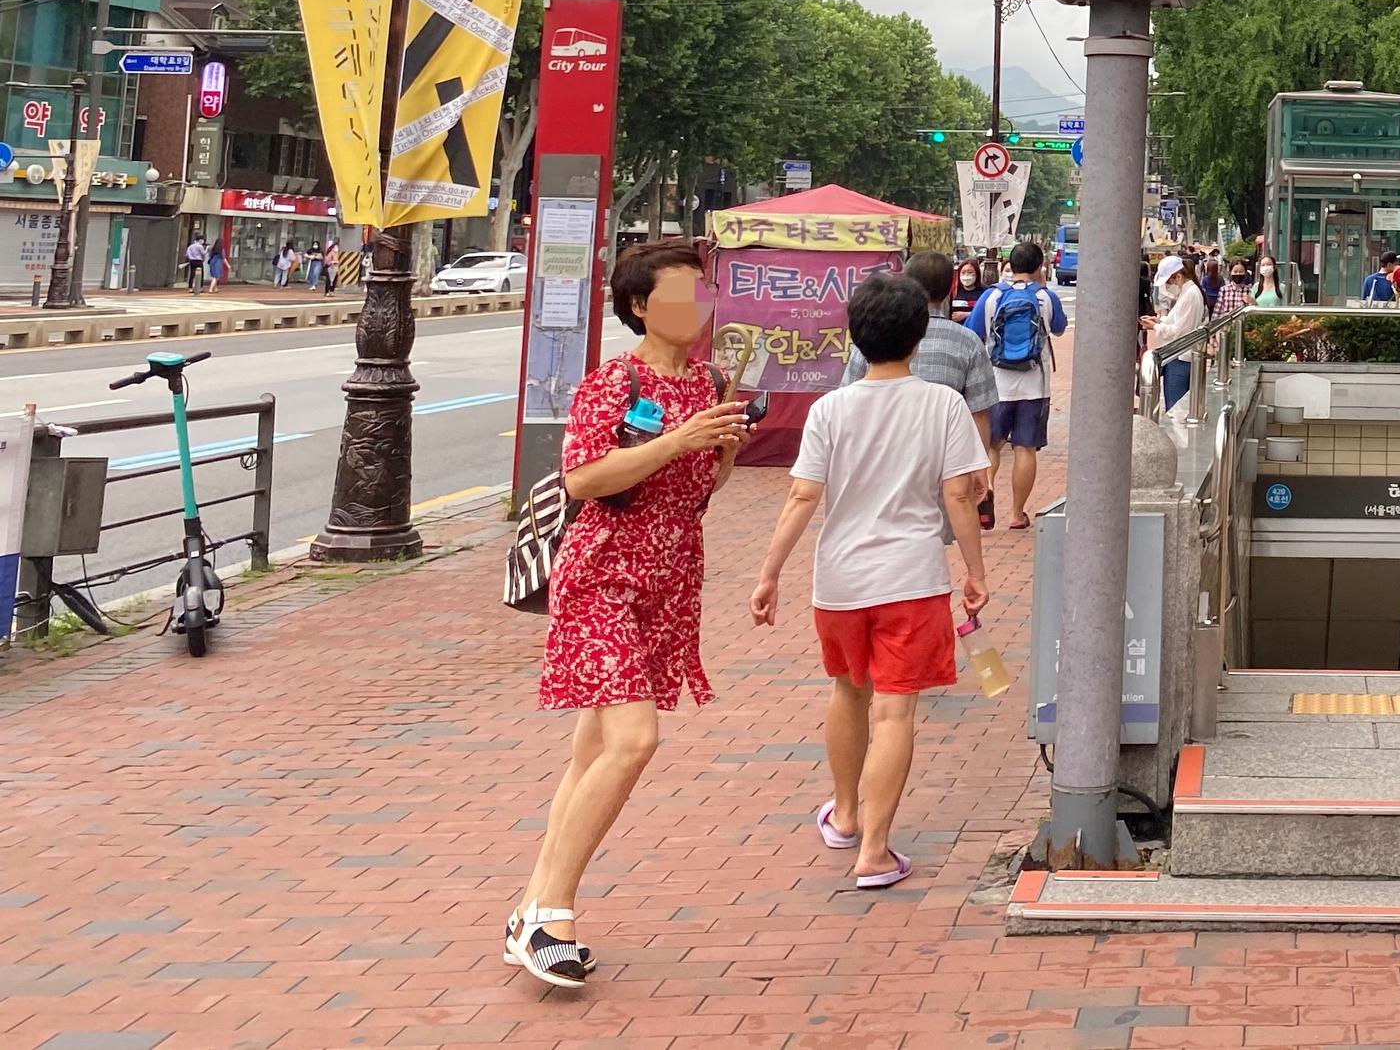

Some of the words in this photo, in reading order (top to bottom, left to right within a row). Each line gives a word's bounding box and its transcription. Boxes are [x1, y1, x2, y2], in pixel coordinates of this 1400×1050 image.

[548, 60, 574, 73] City
[578, 61, 607, 71] Tour
[204, 95, 219, 111] 약
[24, 101, 51, 137] 약
[720, 217, 775, 242] 사주
[784, 219, 839, 244] 타로
[848, 217, 902, 246] 궁합
[785, 371, 828, 382] 10,000~
